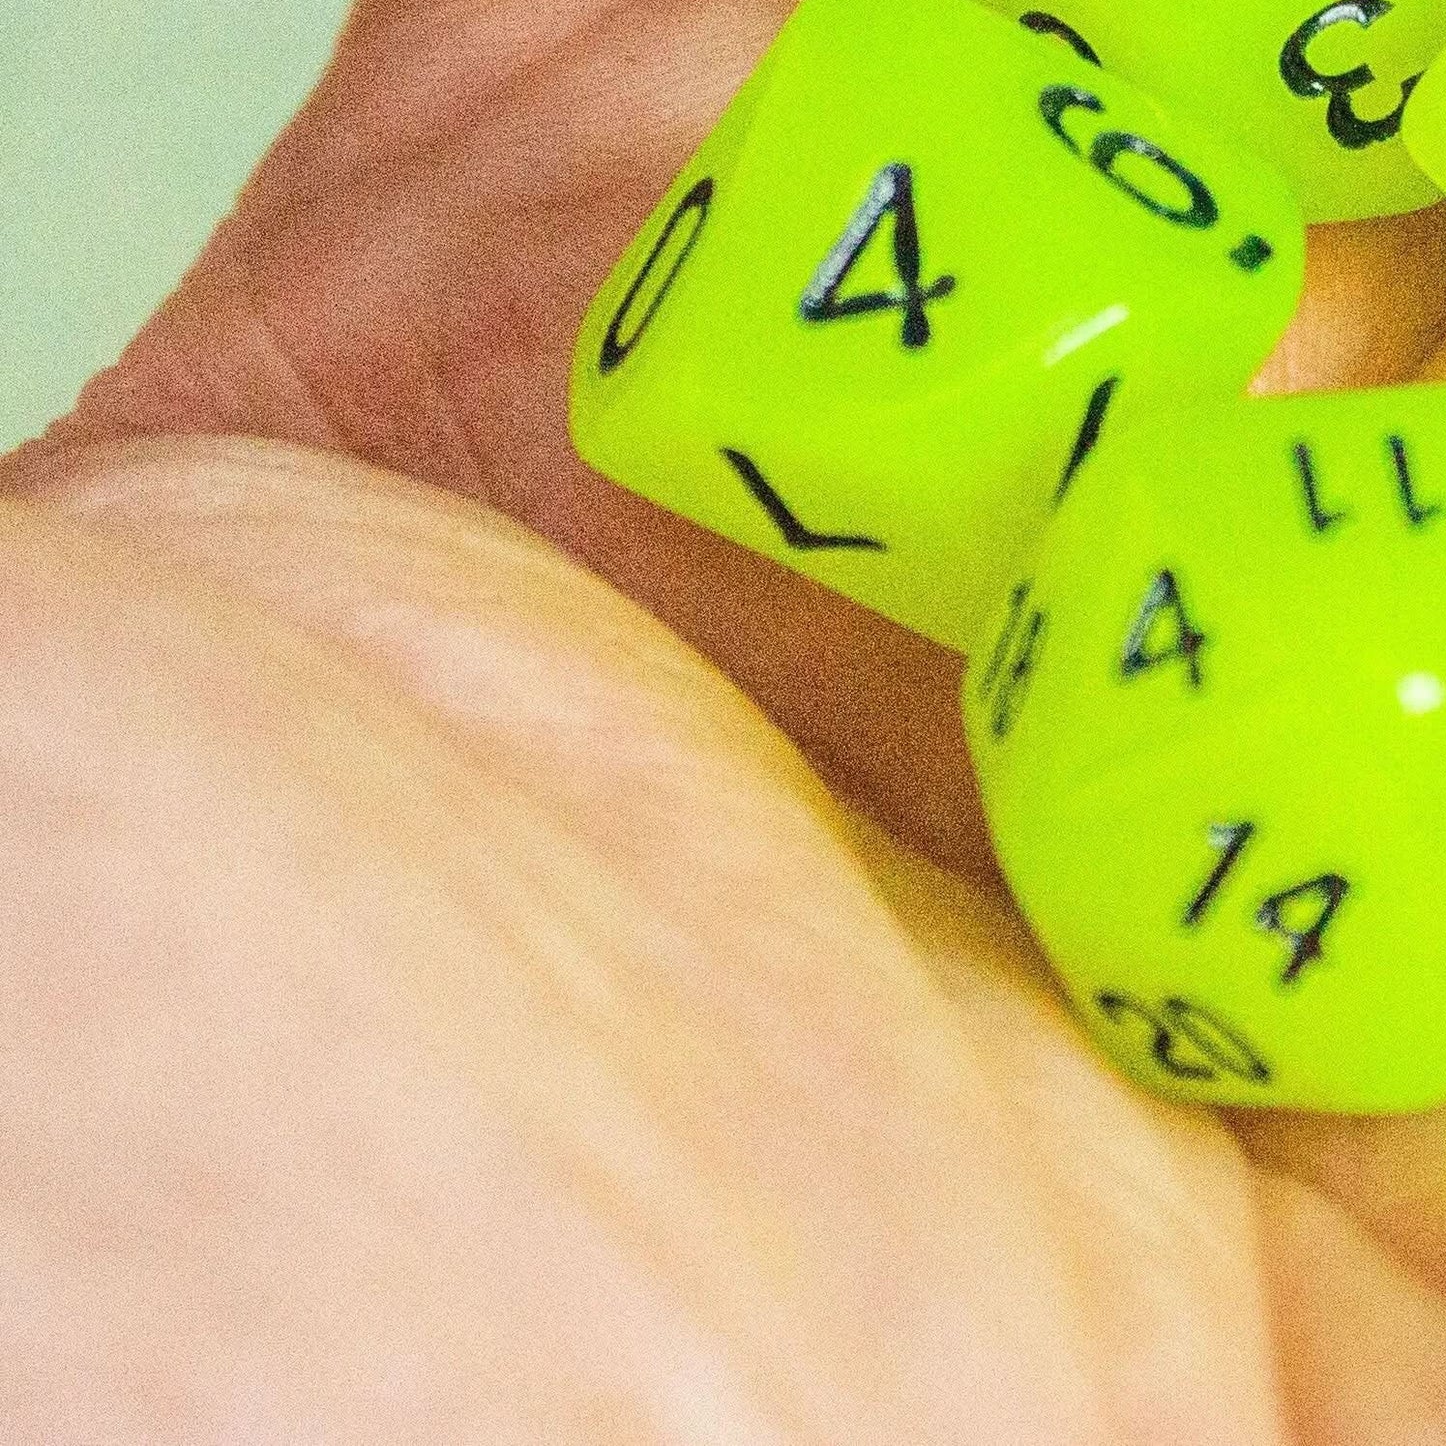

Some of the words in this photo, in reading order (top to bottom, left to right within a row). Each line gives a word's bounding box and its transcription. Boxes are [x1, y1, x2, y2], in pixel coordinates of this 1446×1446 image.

[799, 162, 957, 351] 4
[1119, 567, 1210, 691] 4
[1181, 819, 1352, 988] 14
